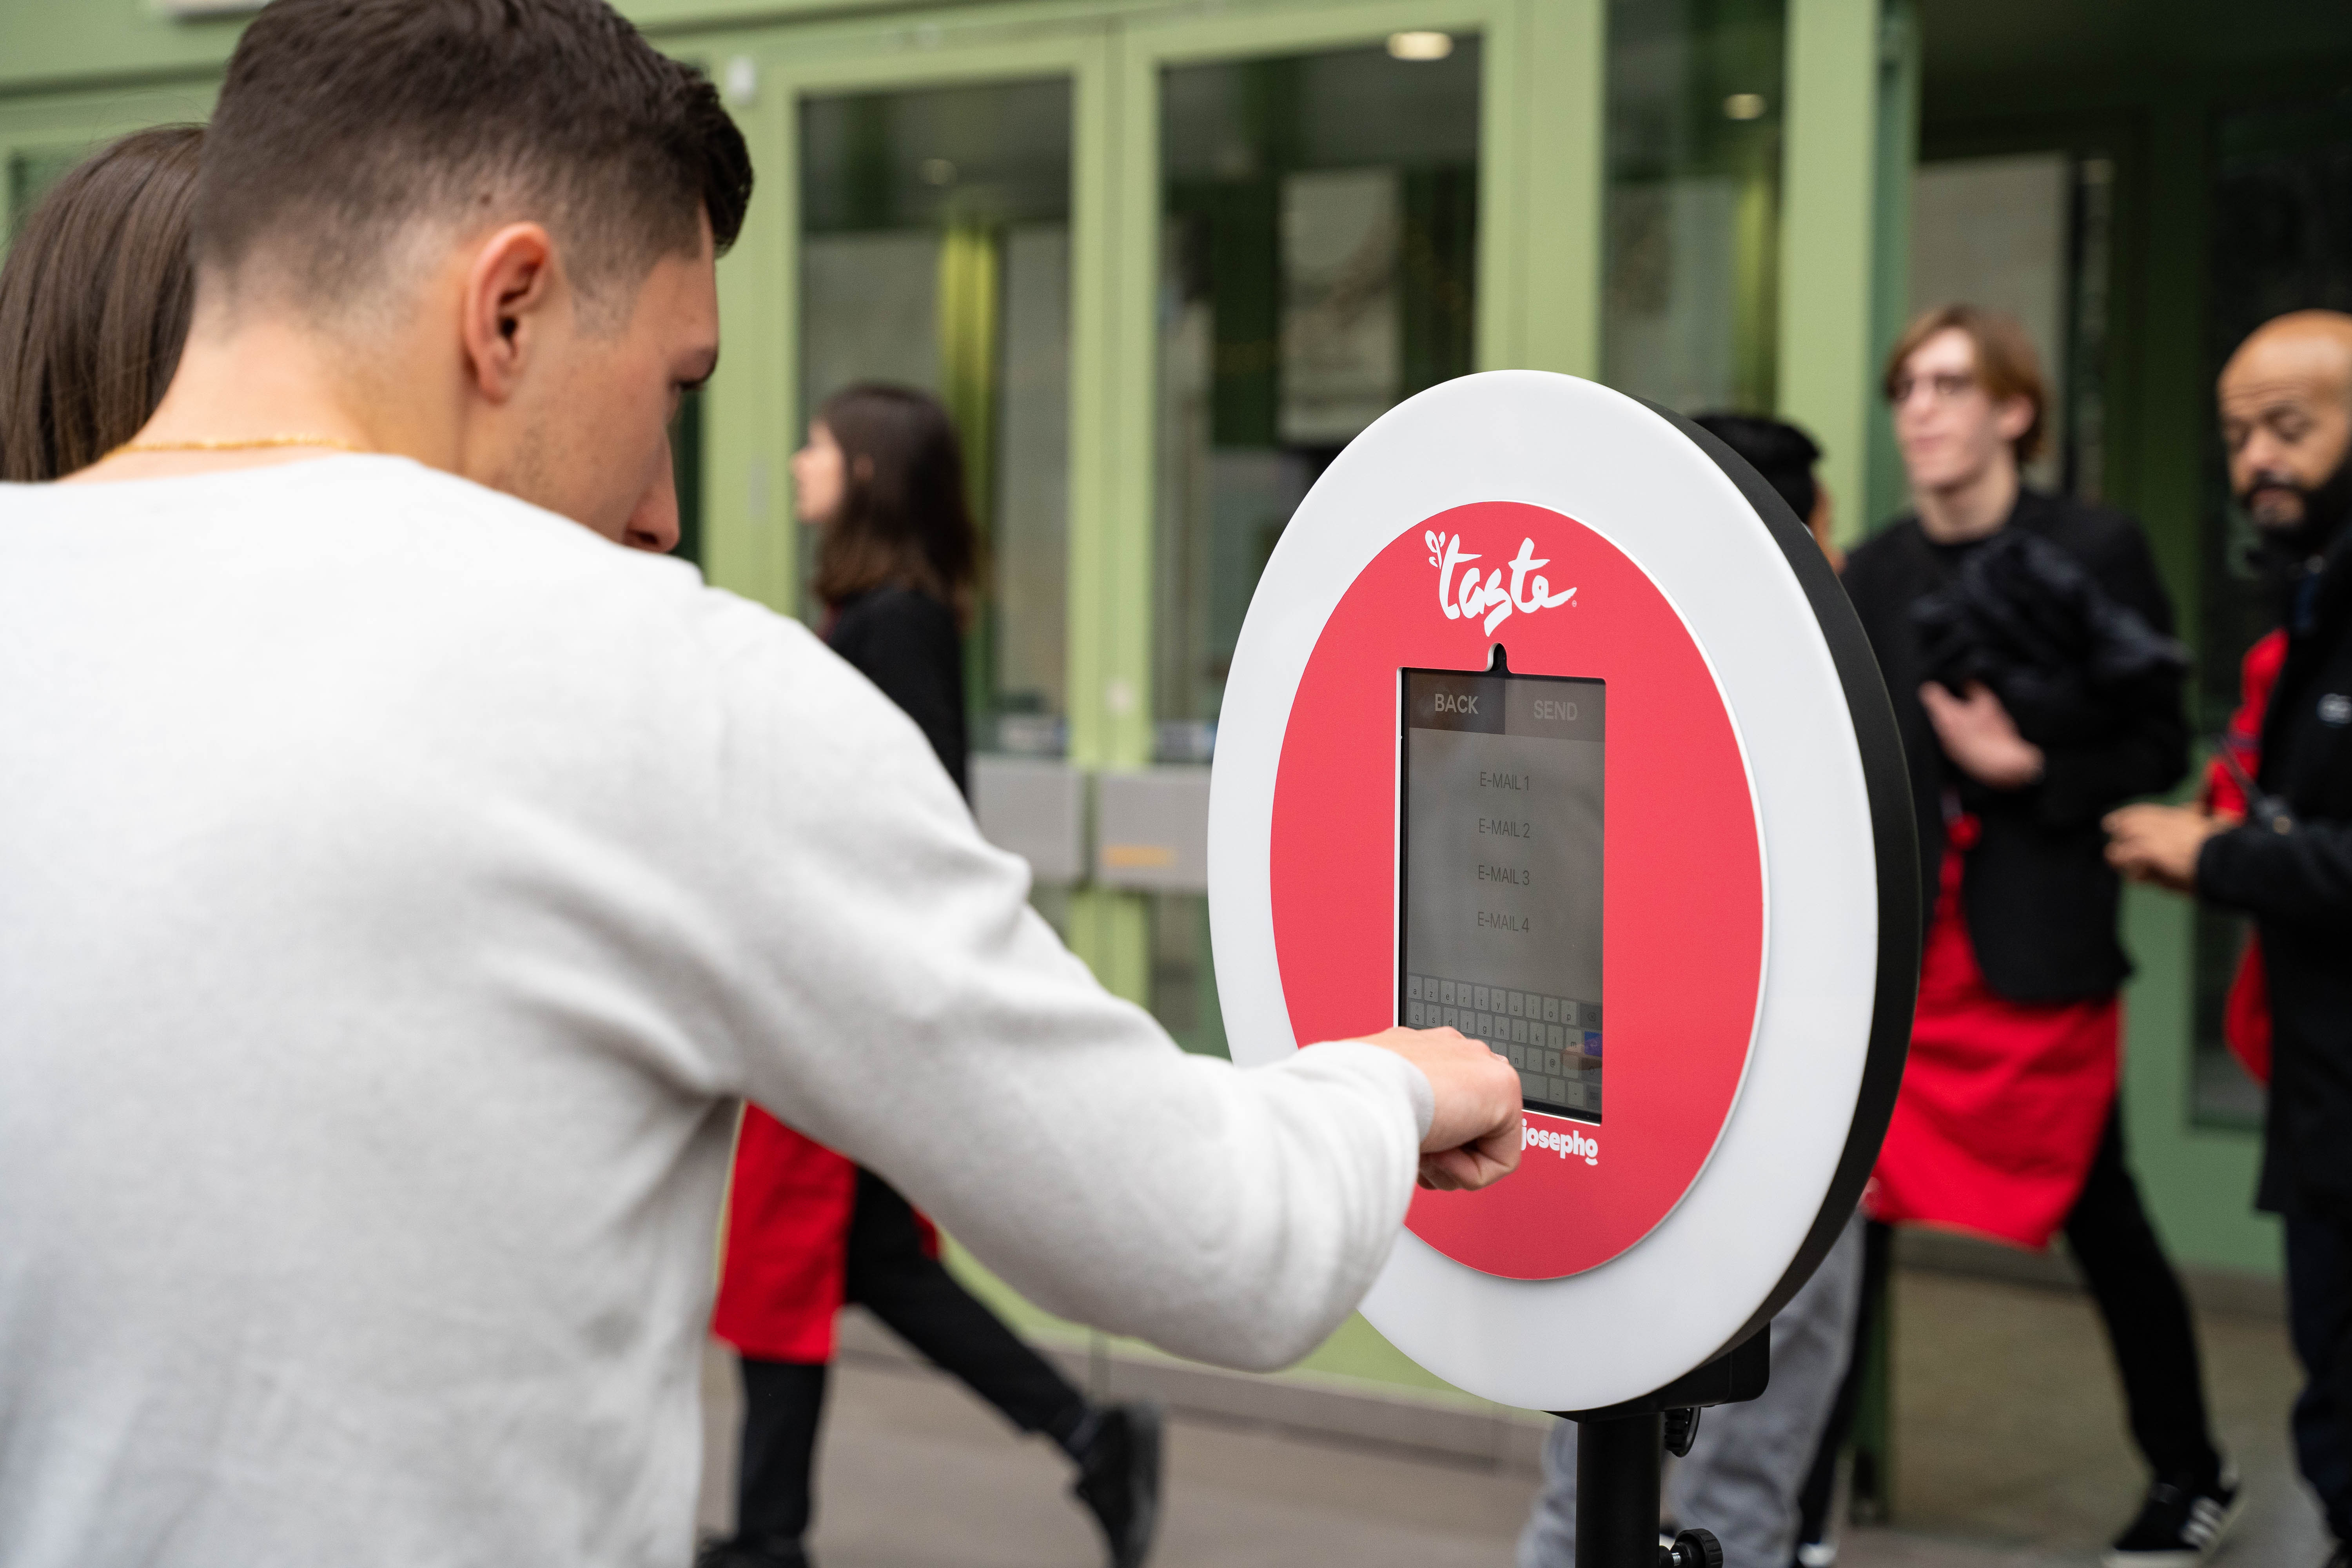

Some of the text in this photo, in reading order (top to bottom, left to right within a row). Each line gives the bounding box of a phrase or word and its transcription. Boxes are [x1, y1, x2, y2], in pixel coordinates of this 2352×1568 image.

[1439, 532, 1577, 637] taste
[1435, 694, 1478, 714] BACK
[1534, 700, 1577, 721] SEND
[1480, 772, 1529, 790] E-MAIL 1
[1479, 818, 1530, 838] E-MAIL 2
[1478, 865, 1530, 885] E-MAIL 3
[1477, 911, 1529, 933] E-MAIL 4
[1496, 1002, 1501, 1011] y
[1566, 1014, 1571, 1022] p
[1415, 1014, 1419, 1022] q
[1466, 1021, 1469, 1029] f
[1483, 1025, 1487, 1034] g
[1500, 1027, 1504, 1036] h
[1535, 1034, 1539, 1042] k
[1521, 1118, 1598, 1165] josepho
